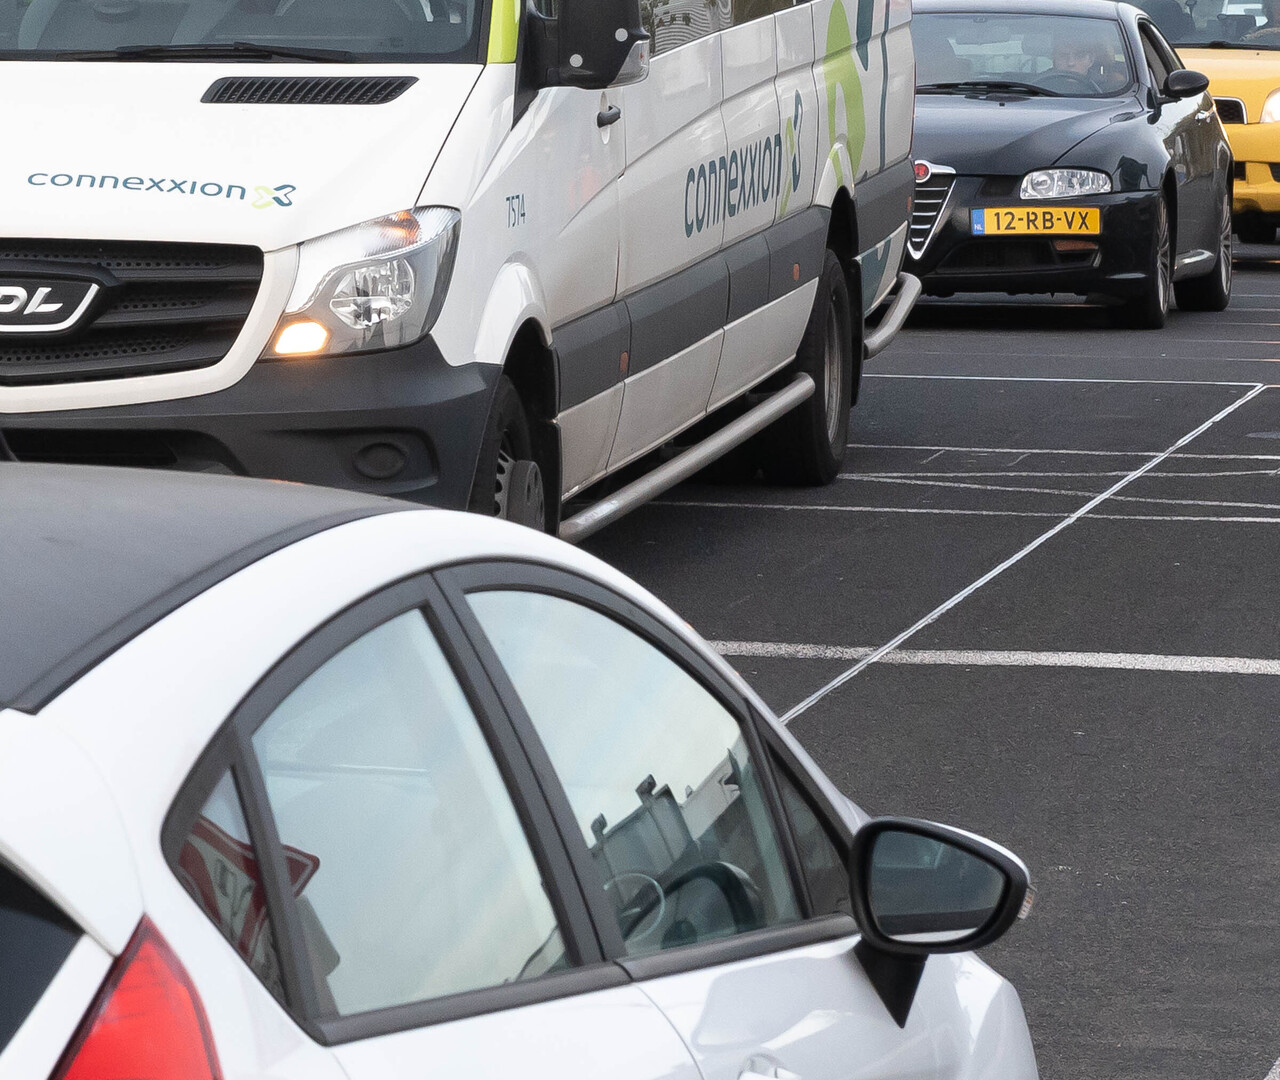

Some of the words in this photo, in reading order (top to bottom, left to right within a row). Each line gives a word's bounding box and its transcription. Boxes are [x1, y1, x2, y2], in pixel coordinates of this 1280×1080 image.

[27, 172, 247, 200] connexxion
[684, 133, 782, 238] connexxion
[505, 193, 526, 229] 7574
[993, 210, 1090, 231] 12-RB-VX
